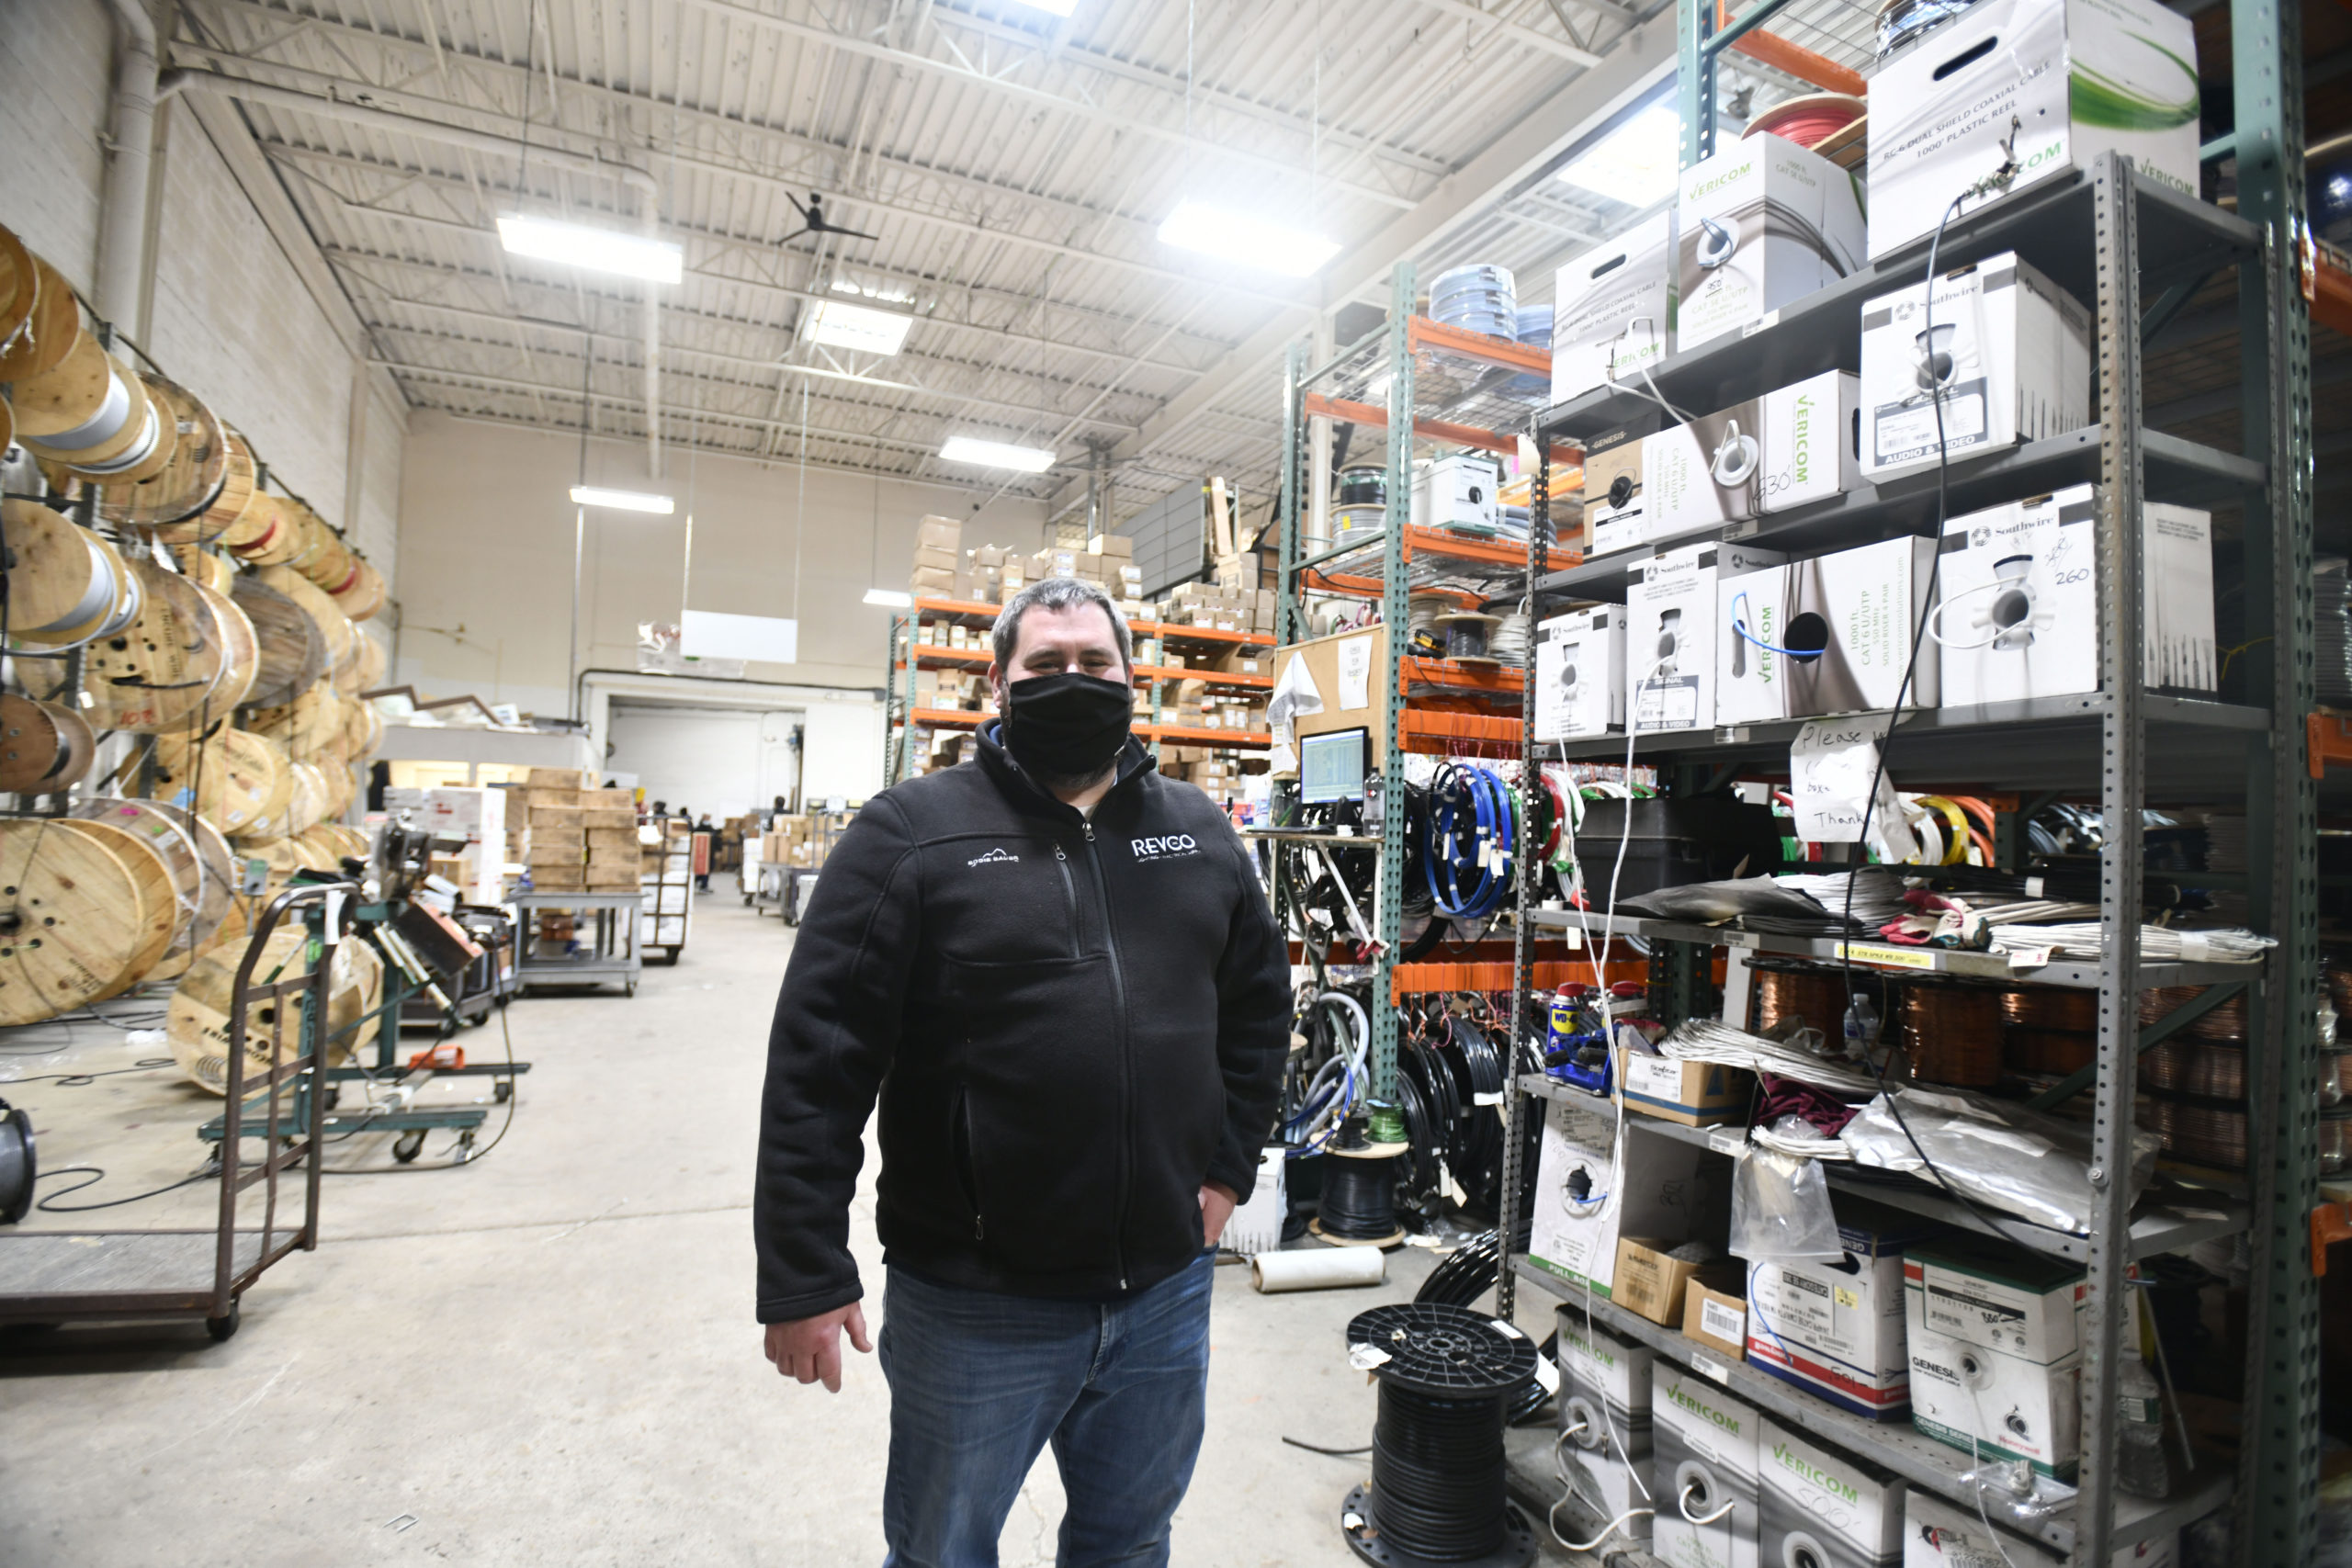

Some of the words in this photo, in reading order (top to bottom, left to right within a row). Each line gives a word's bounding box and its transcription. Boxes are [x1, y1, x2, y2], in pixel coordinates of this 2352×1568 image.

[1907, 131, 1933, 148] DUAL
[1936, 109, 1972, 134] SHIELD
[1973, 84, 2018, 113] COAXIAL
[2019, 60, 2052, 86] CABLE
[1947, 116, 1989, 142] PLASTIC
[1991, 99, 2018, 119] REEL
[1689, 162, 1751, 200] VERICOM
[2141, 157, 2195, 196] VERICOM
[1611, 292, 1636, 308] COAXIAL
[1637, 281, 1657, 295] CABLE
[1595, 310, 1620, 325] PLASTIC
[1621, 302, 1635, 314] REEL
[1592, 431, 1625, 449] GENESIS
[1796, 394, 1815, 483] VERICOM
[1884, 447, 1923, 465] AUDIO
[1925, 445, 1936, 455] &
[1995, 516, 2054, 536] Southwire
[1660, 560, 1696, 573] Southwire
[2054, 568, 2090, 586] 260
[1861, 590, 1871, 629] U/UTP
[1850, 625, 1860, 650] 1000
[1861, 630, 1871, 638] 6
[1861, 643, 1871, 666] CAT
[1668, 720, 1690, 728] VIDEO
[1802, 725, 1862, 750] Please
[1131, 833, 1196, 857] REVCO
[1548, 1263, 1569, 1279] PULL
[1667, 1383, 1740, 1434] VERICOM
[1915, 1416, 1948, 1435] GENESIS
[1998, 1435, 2041, 1455] Honeywell
[1773, 1442, 1858, 1505] VERICOM
